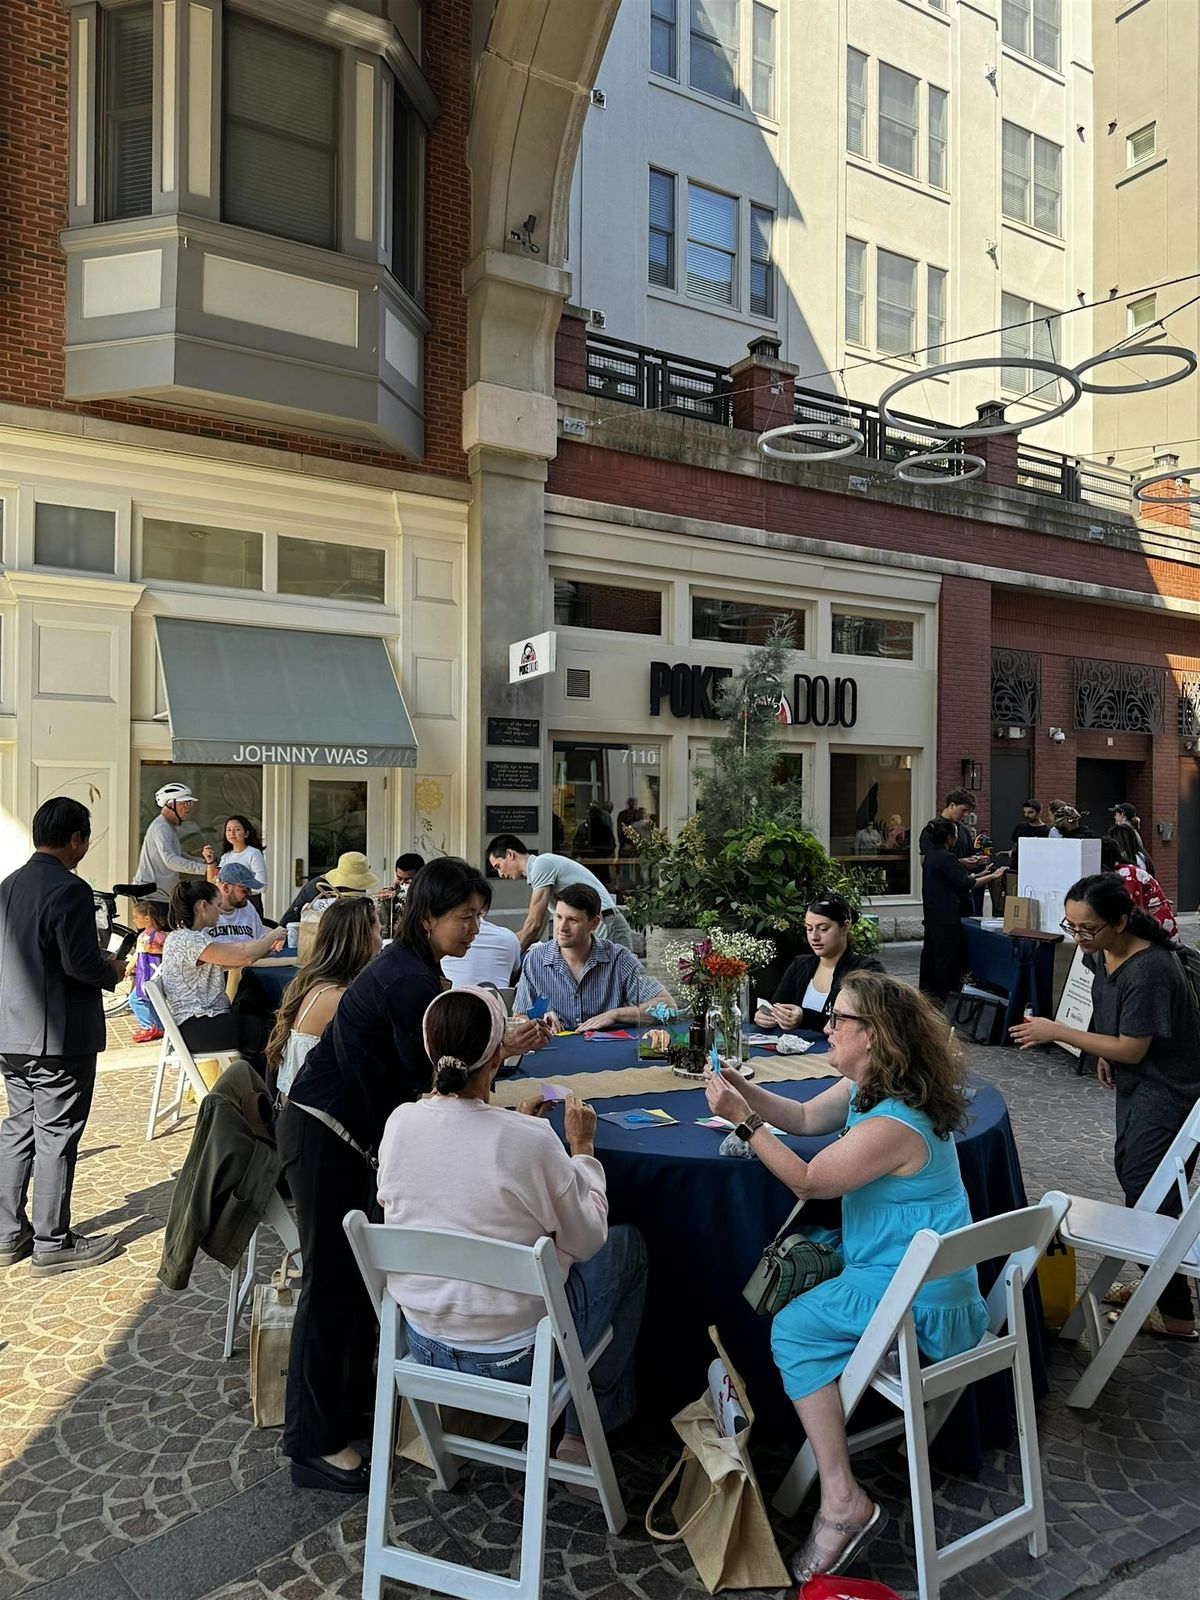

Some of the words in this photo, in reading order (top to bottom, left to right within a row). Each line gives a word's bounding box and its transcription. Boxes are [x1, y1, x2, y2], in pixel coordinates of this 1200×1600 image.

[650, 661, 732, 720] POKE
[793, 673, 858, 728] DOJO
[233, 745, 319, 763] JOHNNY
[324, 748, 369, 764] WAS
[621, 749, 656, 765] 7110
